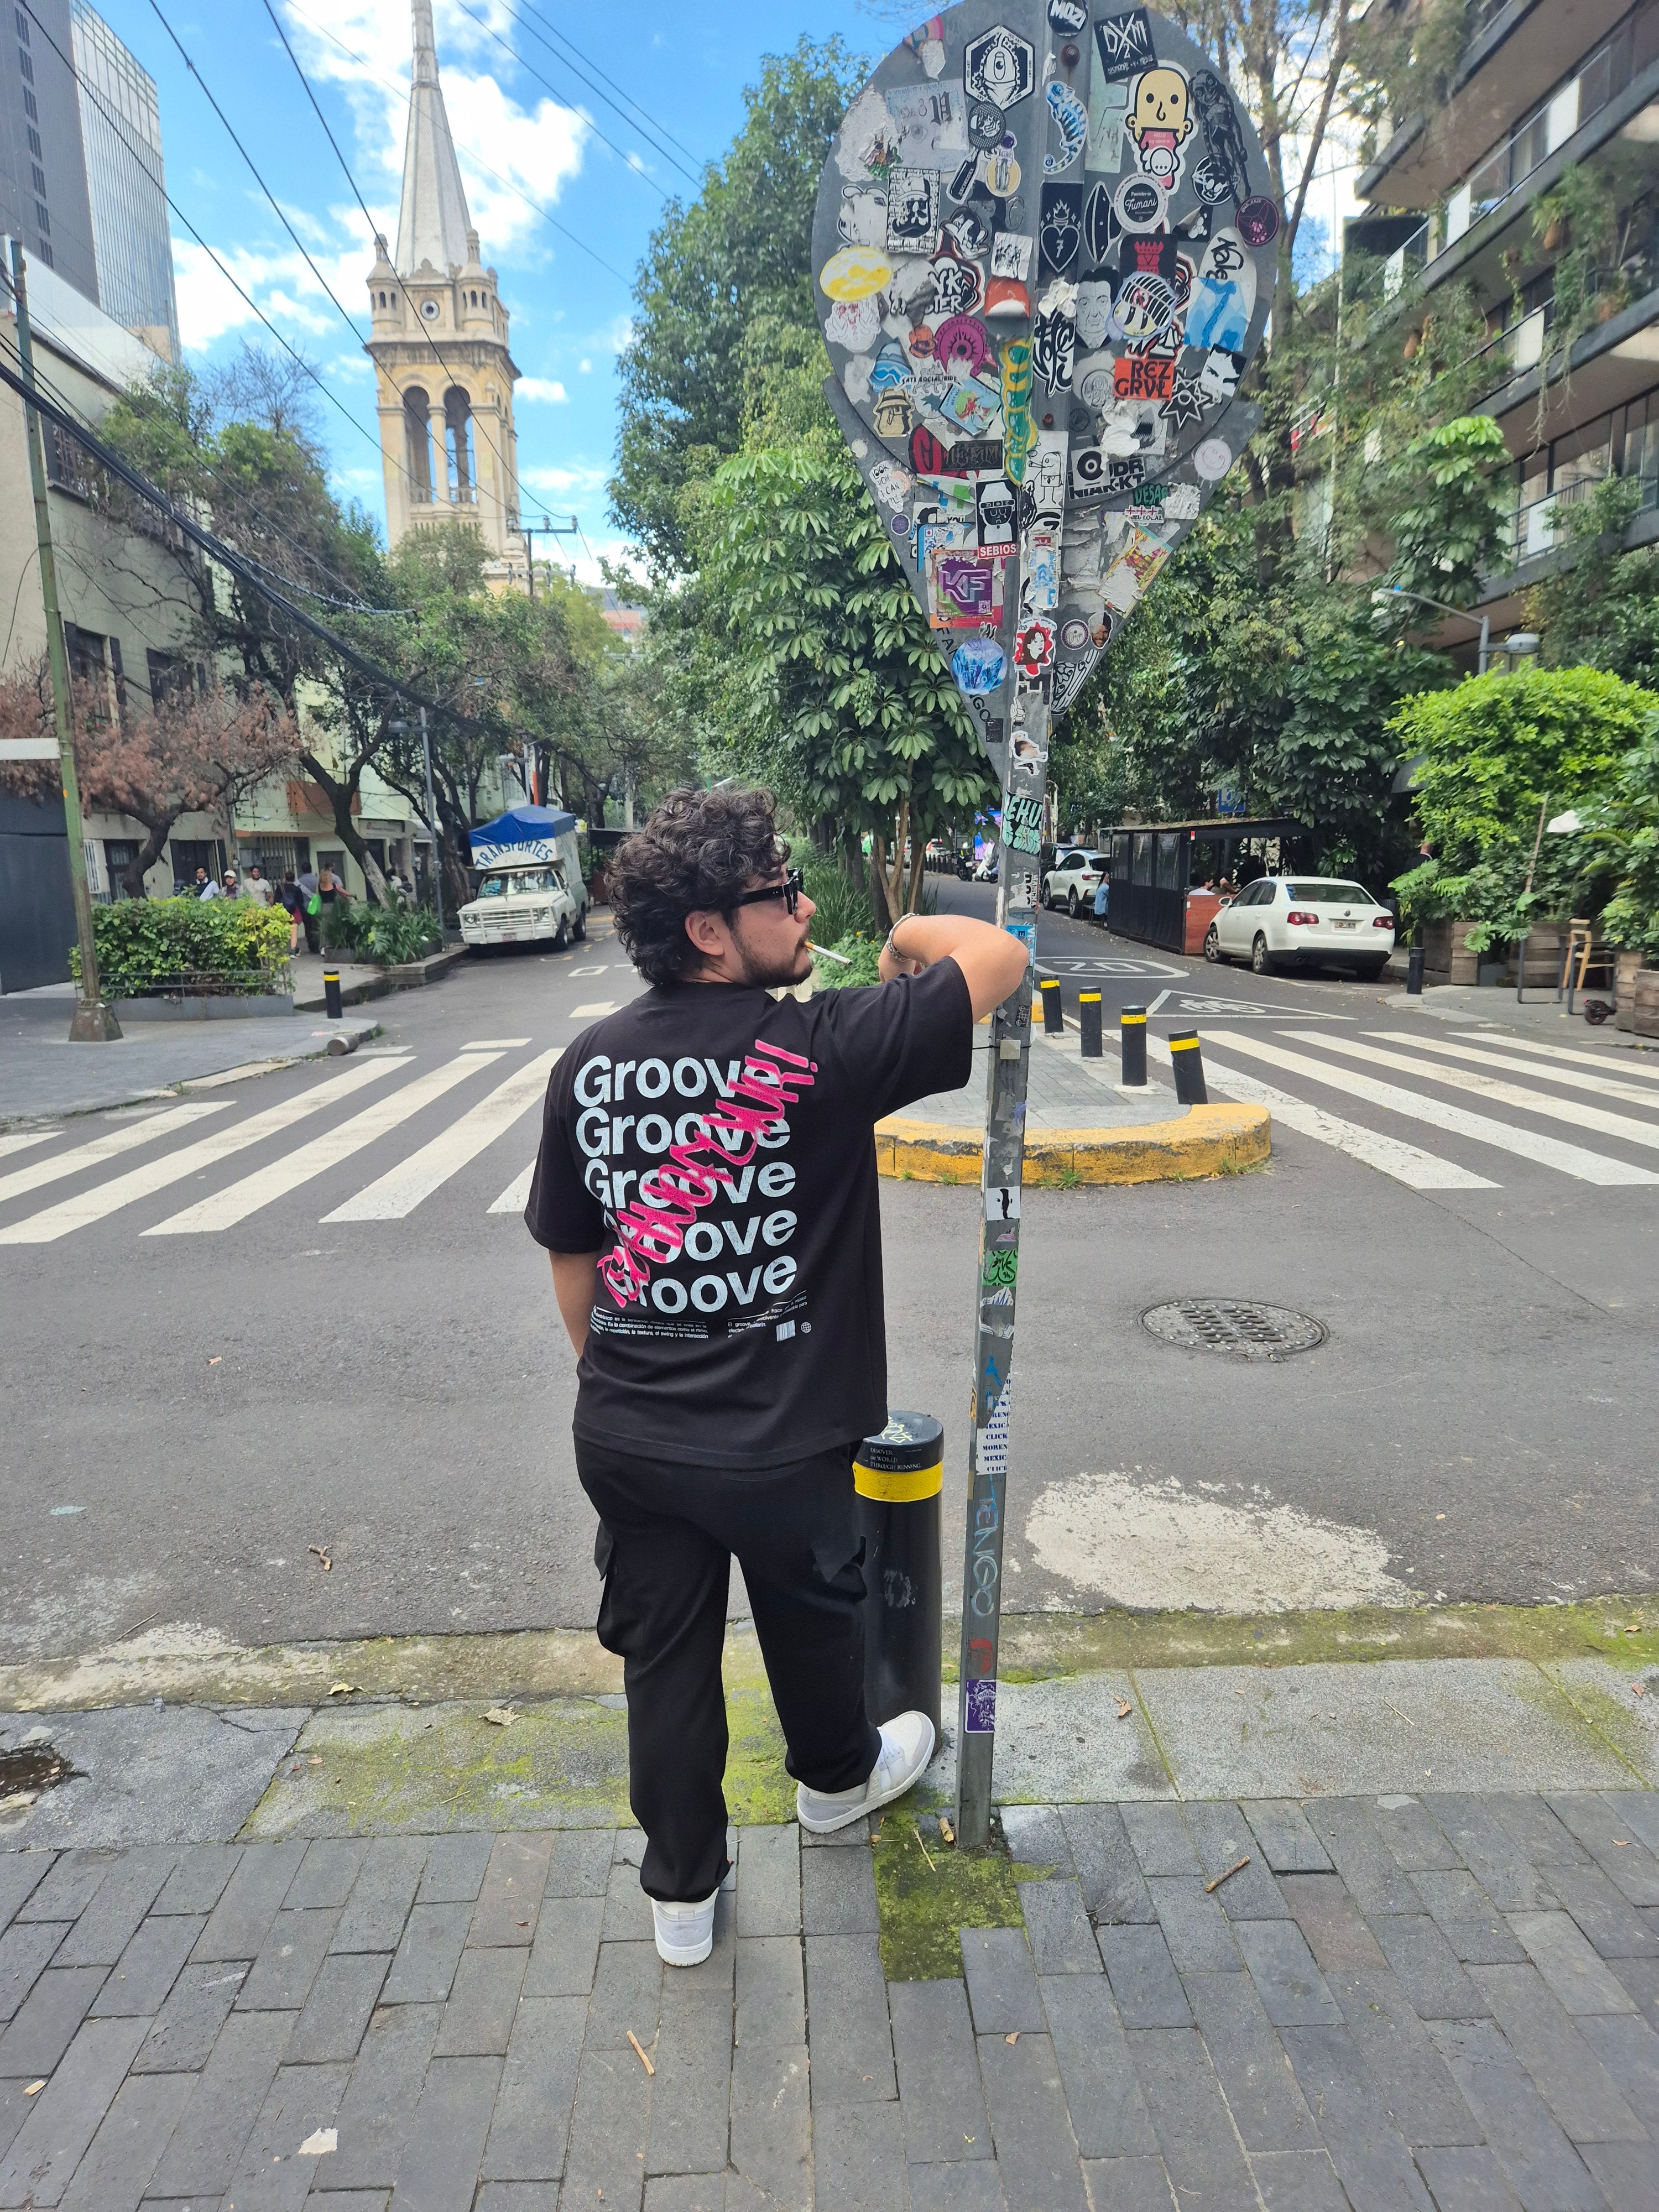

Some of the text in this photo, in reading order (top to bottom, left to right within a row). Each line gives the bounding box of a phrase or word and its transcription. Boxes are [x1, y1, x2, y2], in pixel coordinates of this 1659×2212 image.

[1131, 361, 1171, 379] REZ
[980, 543, 1017, 557] SEBIOS
[573, 1055, 781, 1108] Groove
[576, 1107, 791, 1157] Groove
[584, 1159, 796, 1209] Groove
